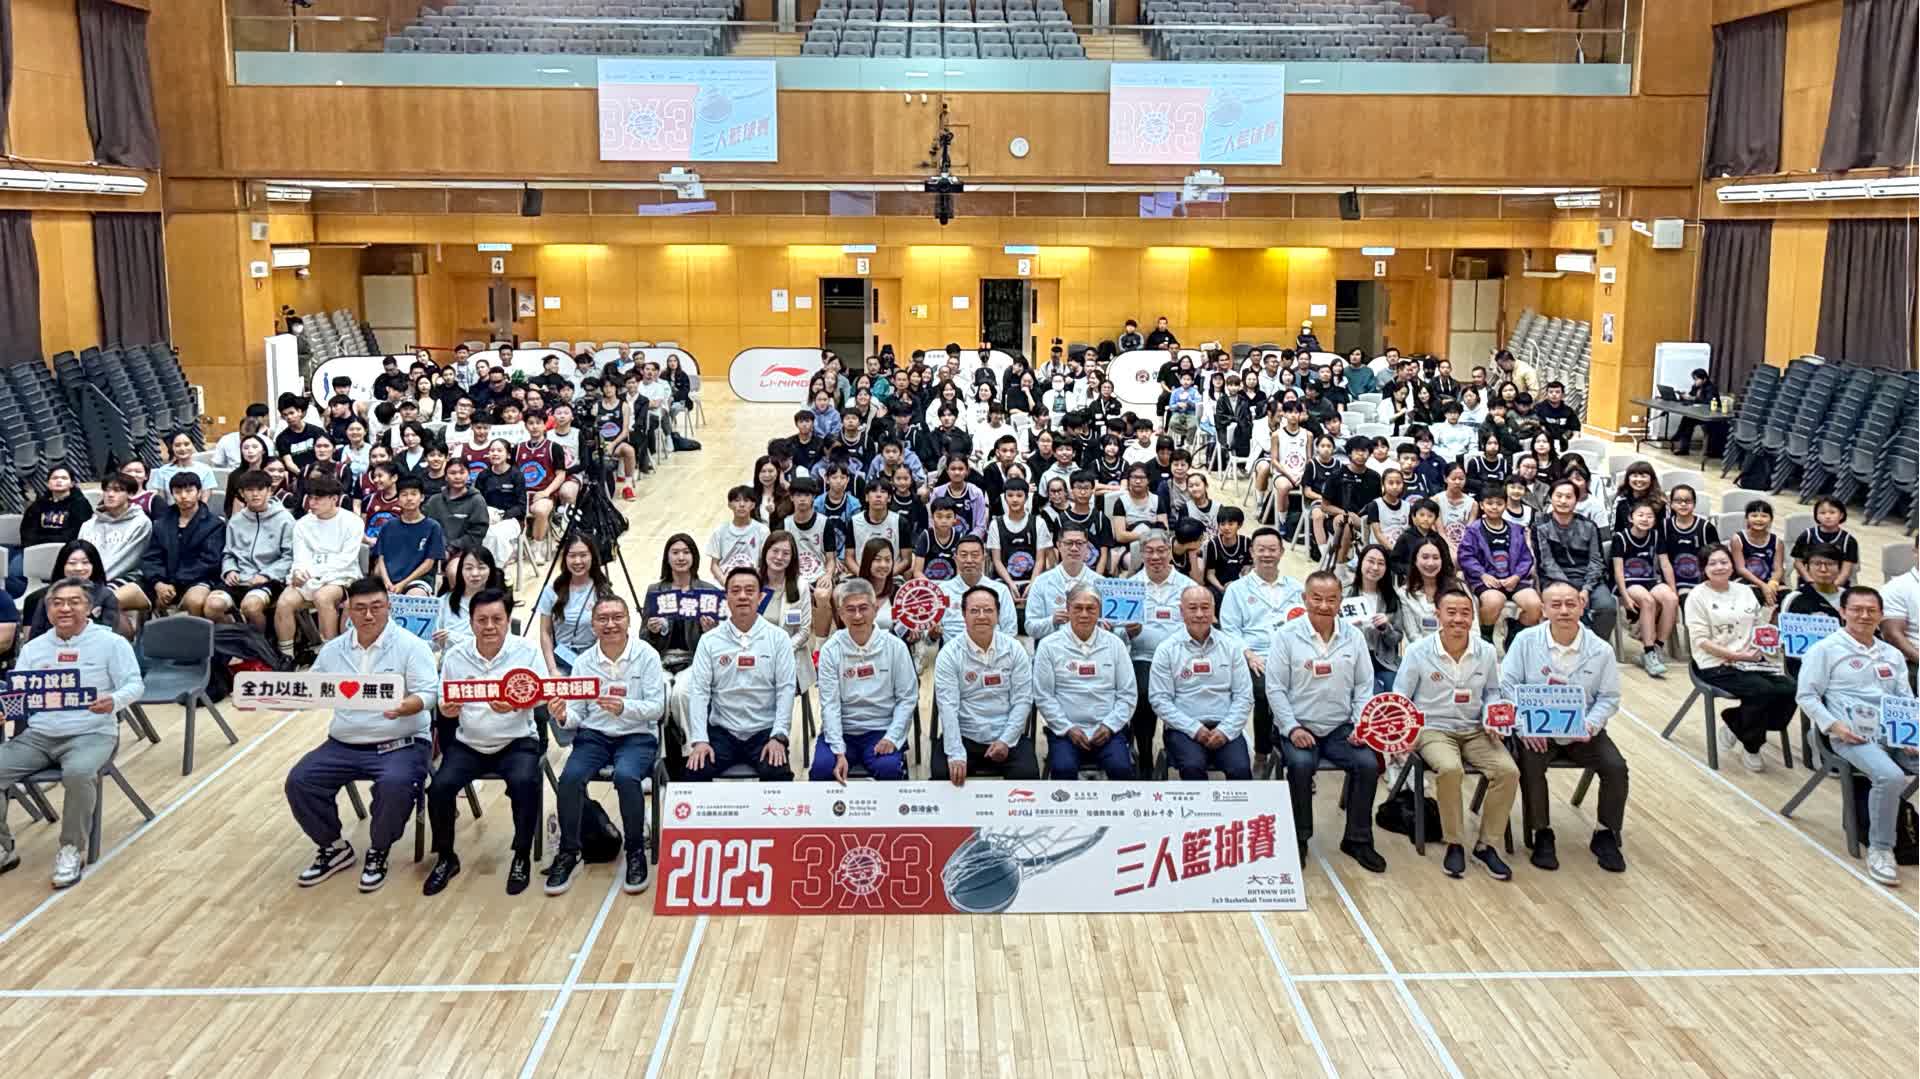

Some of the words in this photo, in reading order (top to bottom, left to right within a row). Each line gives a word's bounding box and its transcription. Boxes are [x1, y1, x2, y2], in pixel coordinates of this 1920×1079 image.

[494, 260, 502, 270] 4
[860, 261, 867, 272] 3
[1021, 261, 1028, 273] 2
[1377, 263, 1383, 274] 1
[886, 527, 893, 539] 3
[749, 536, 756, 548] 4
[1784, 634, 1809, 655] 12
[1521, 709, 1552, 733] 12
[1560, 709, 1576, 733] 7
[1887, 710, 1911, 720] 2025
[1886, 720, 1918, 746] 12
[761, 803, 812, 817] 大公報
[1114, 814, 1276, 896] 三人籃球賽
[666, 838, 775, 907] 2025
